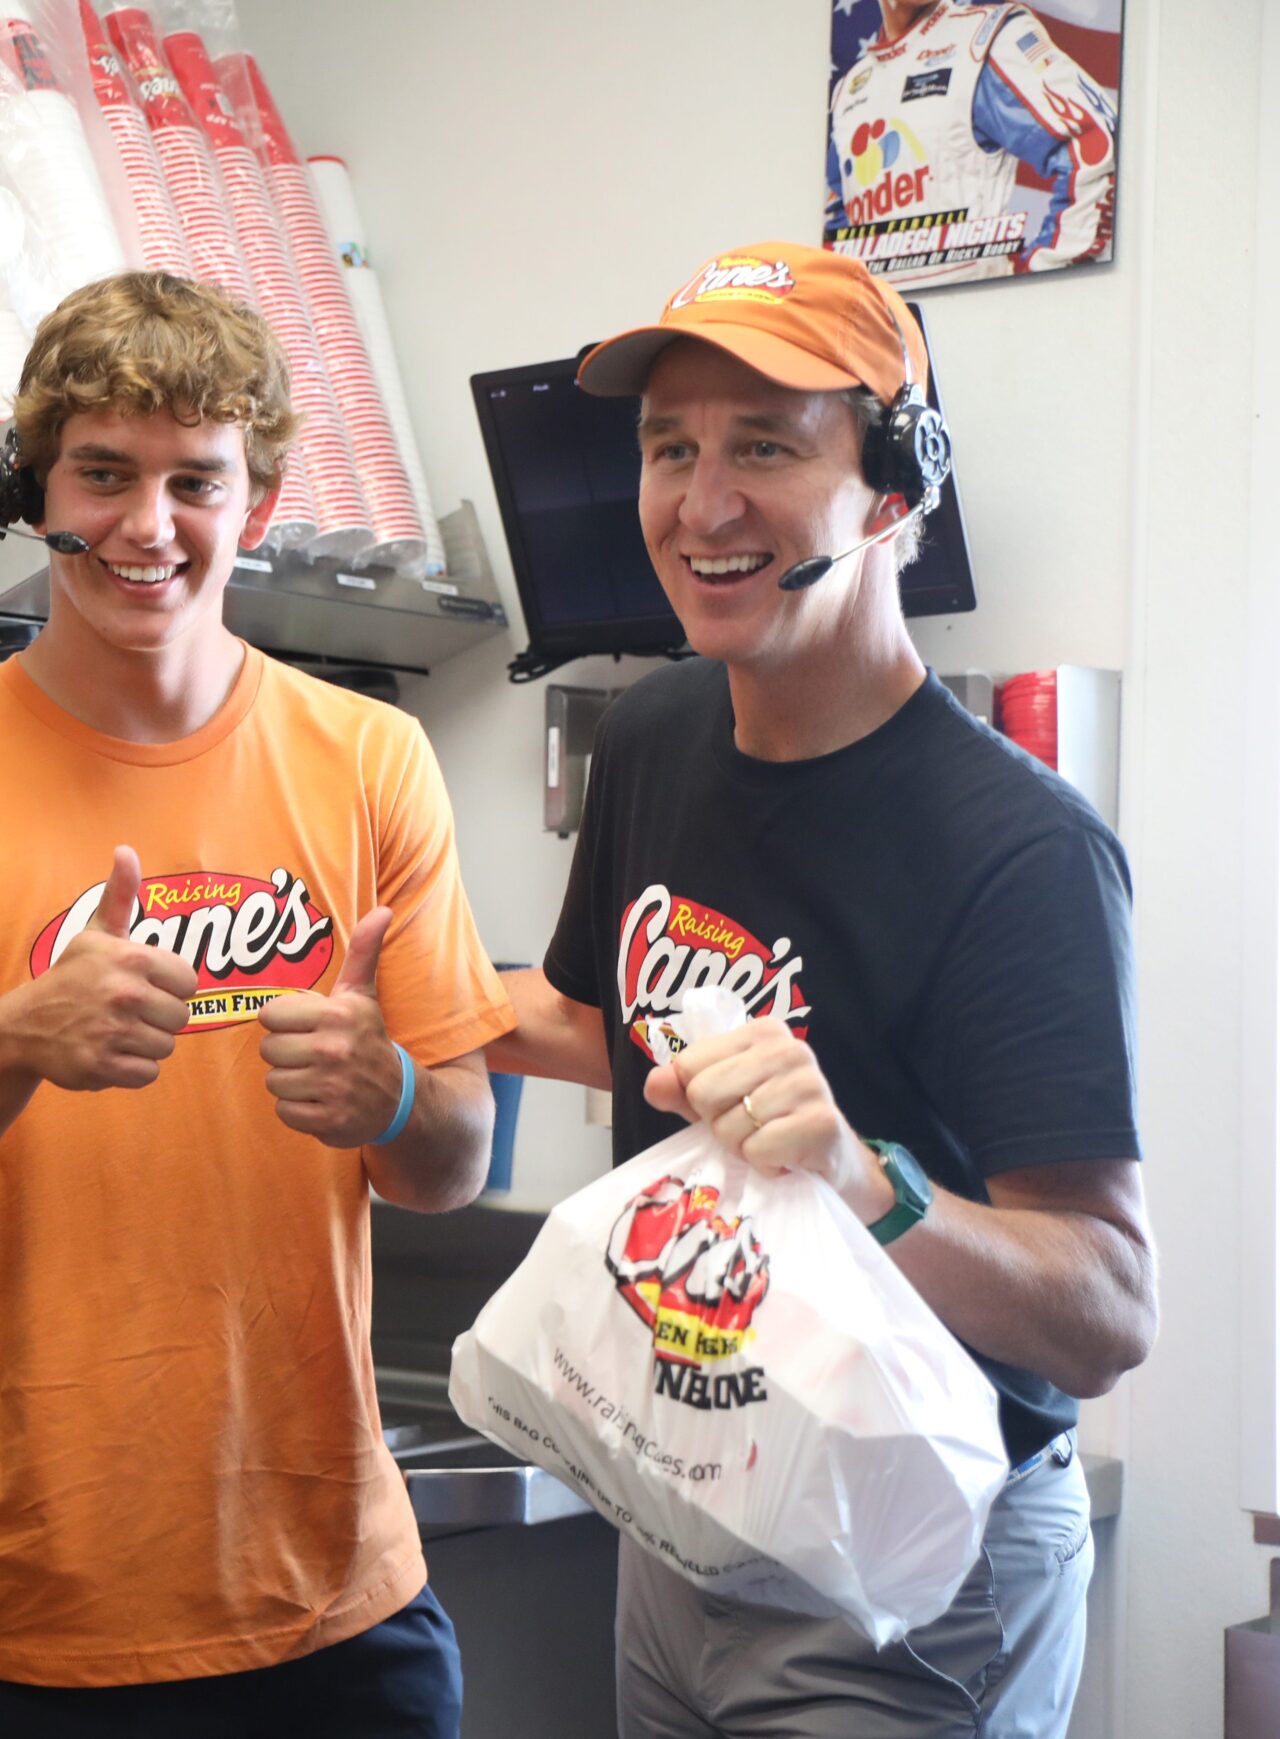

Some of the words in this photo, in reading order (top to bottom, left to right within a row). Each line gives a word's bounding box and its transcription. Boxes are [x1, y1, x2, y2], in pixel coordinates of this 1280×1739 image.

[944, 211, 1028, 249] NIGHTS
[146, 876, 242, 911] Raising
[669, 904, 745, 958] Raising
[513, 1416, 540, 1441] BAG
[614, 1505, 633, 1524] TO
